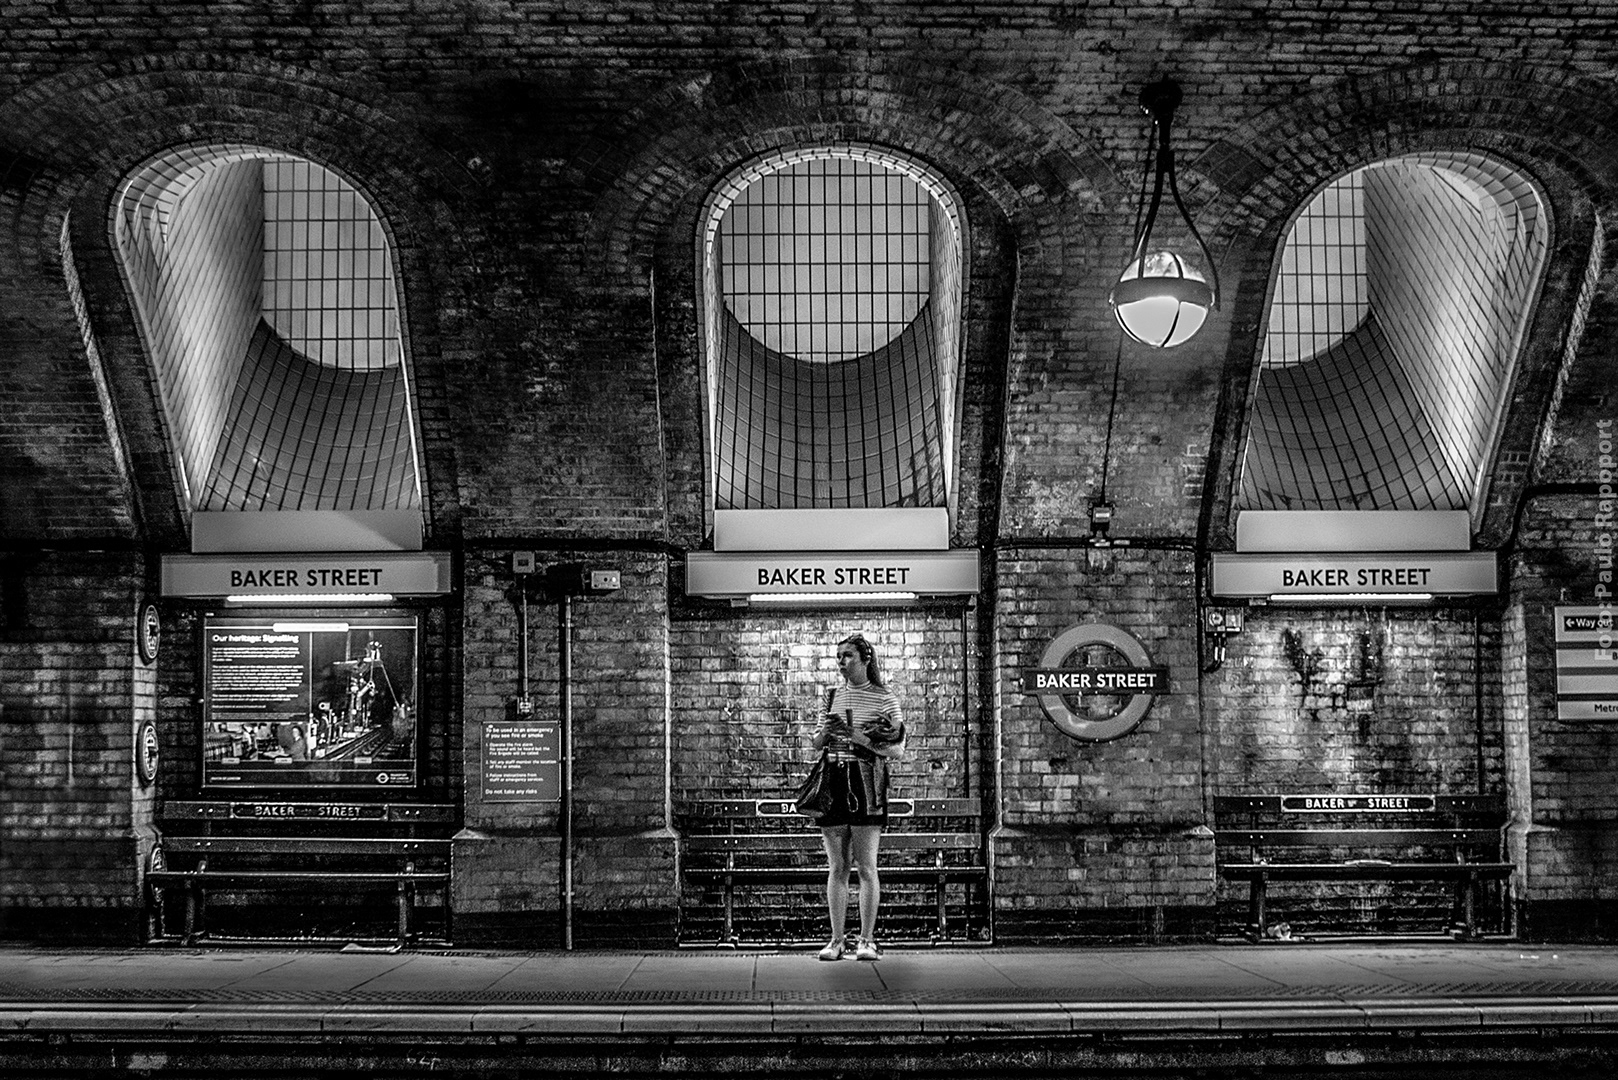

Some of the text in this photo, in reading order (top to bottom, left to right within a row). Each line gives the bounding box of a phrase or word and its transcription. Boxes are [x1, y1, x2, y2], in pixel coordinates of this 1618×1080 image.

[231, 568, 383, 587] BAKER STREET
[757, 567, 910, 586] BAKER STREET
[1282, 568, 1431, 587] BAKER STREET
[1575, 618, 1596, 629] Way
[212, 634, 228, 642] Our
[1036, 673, 1157, 688] BAKER STREET
[1305, 798, 1409, 808] BAKER STREET
[254, 806, 362, 816] BAKER STREET
